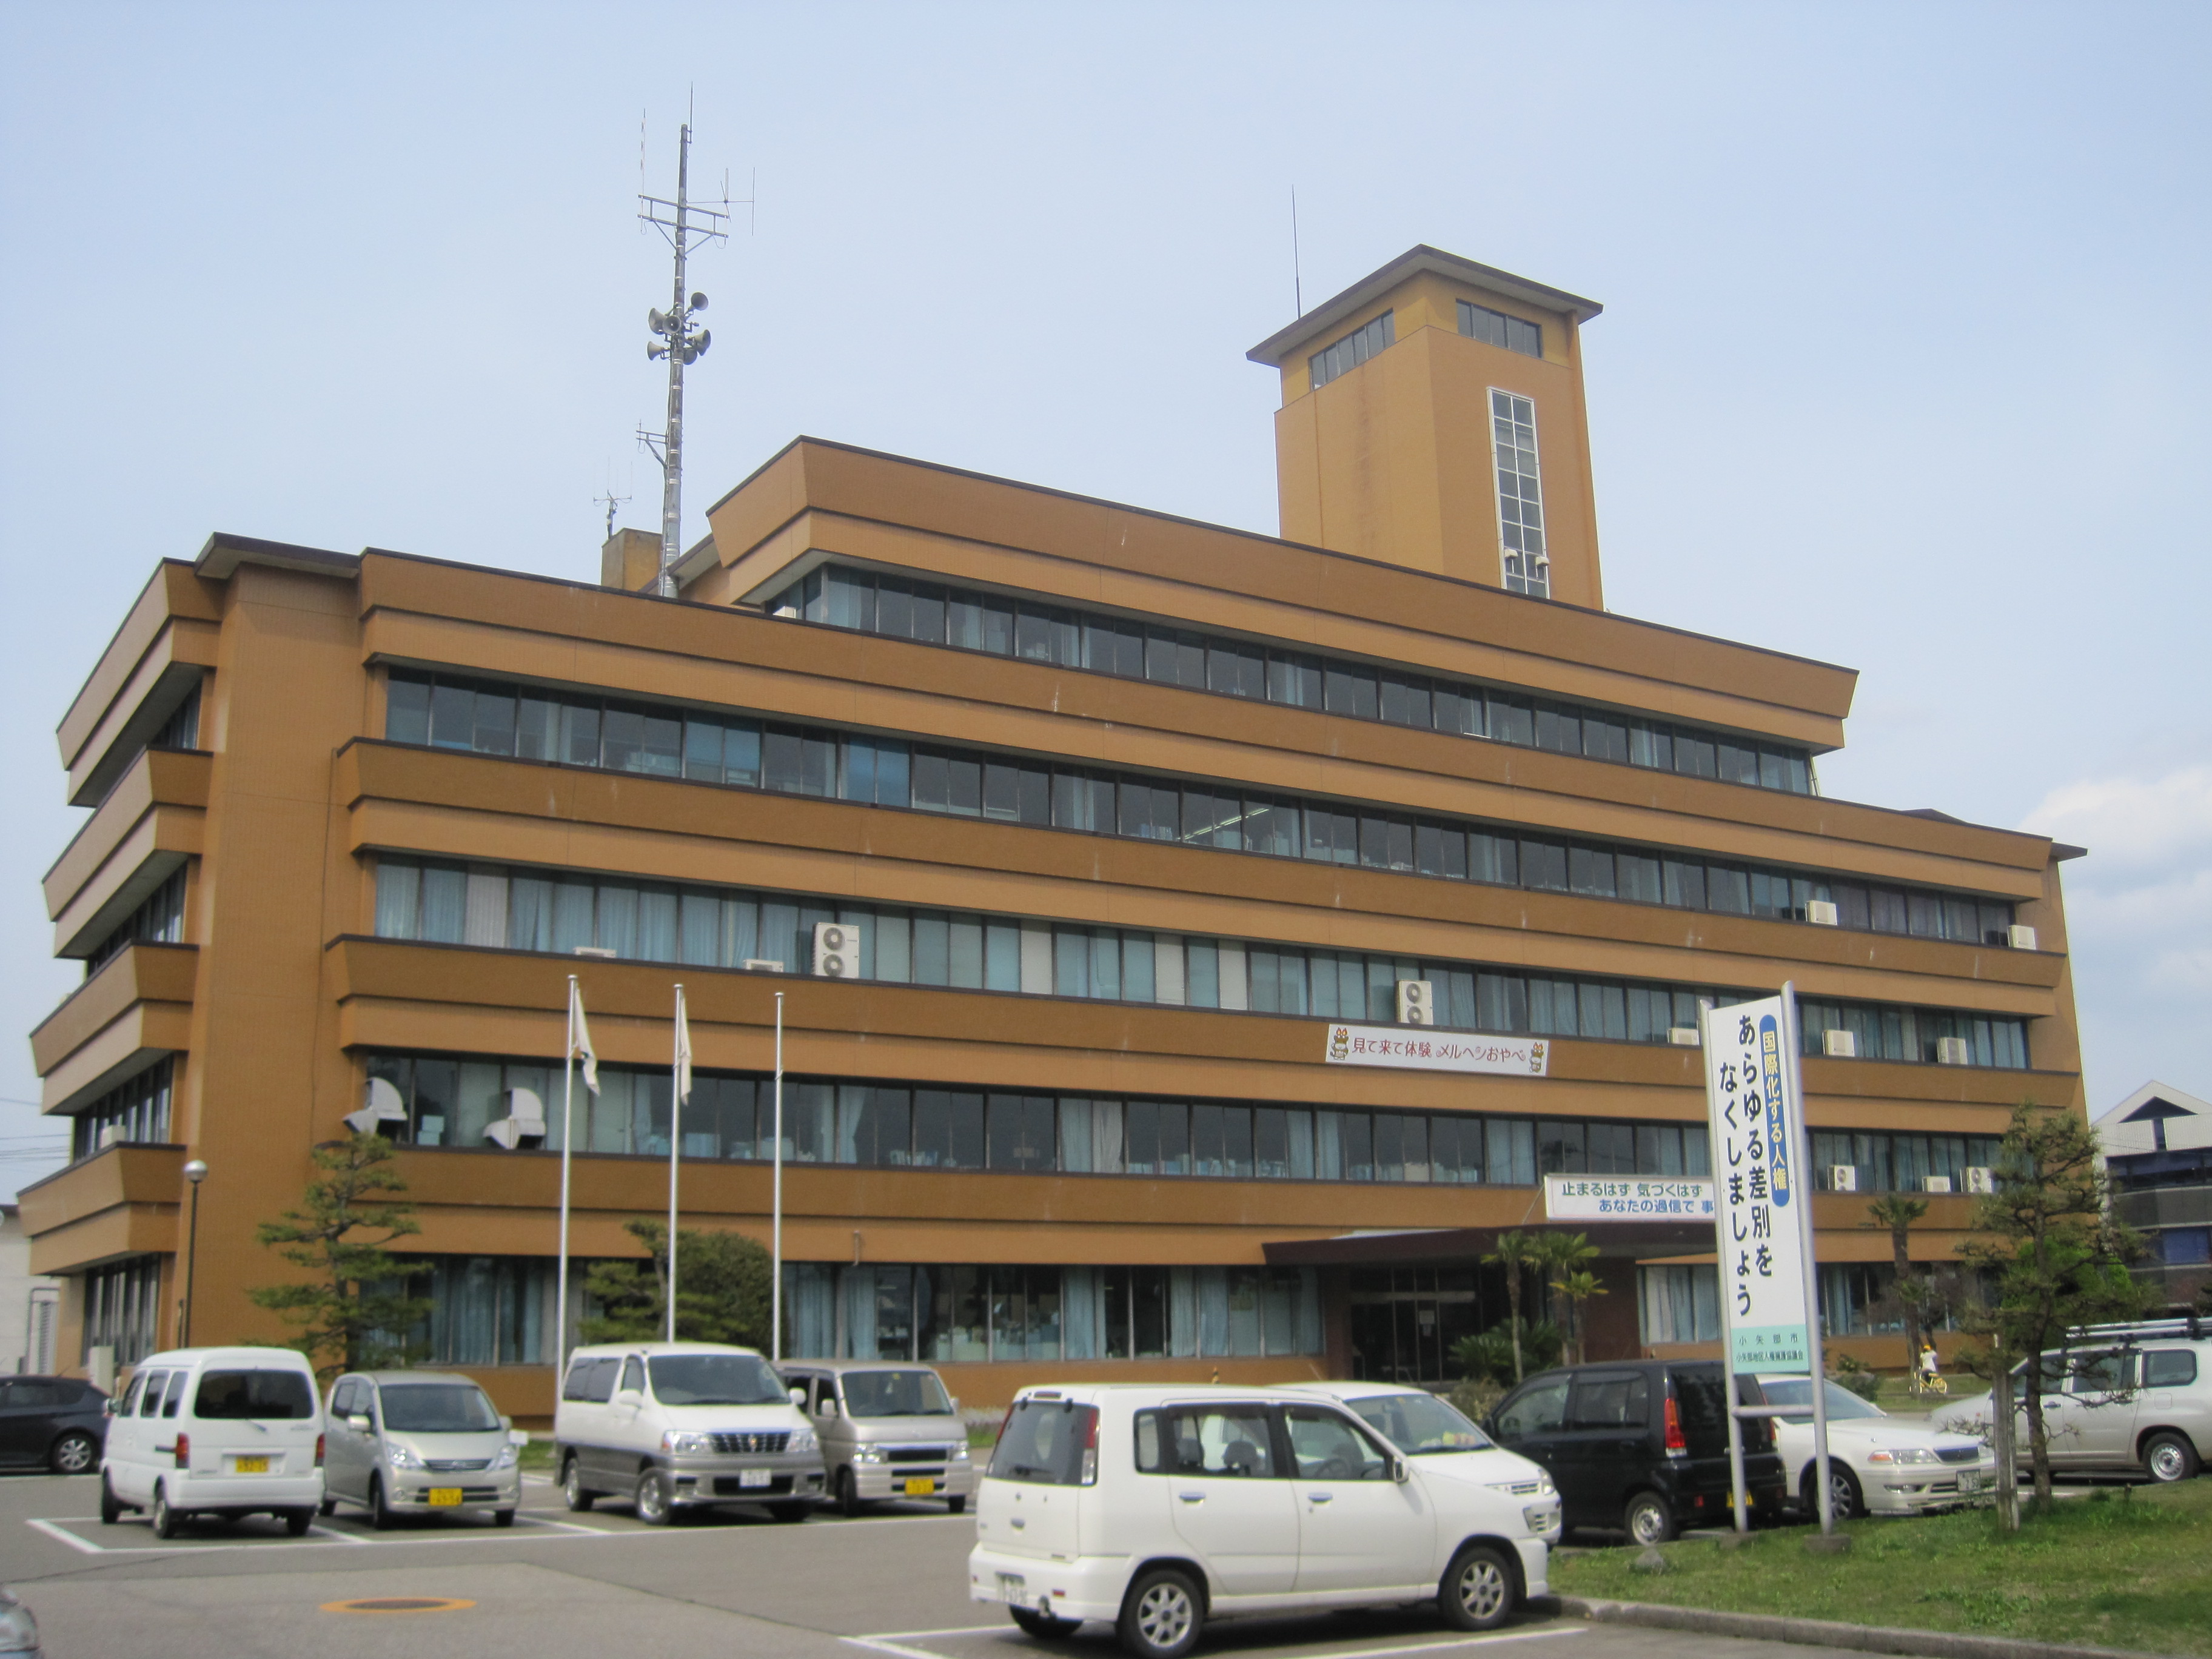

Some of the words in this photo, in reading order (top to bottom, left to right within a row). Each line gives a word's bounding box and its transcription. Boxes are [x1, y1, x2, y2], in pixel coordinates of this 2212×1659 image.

[1352, 1037, 1432, 1057] 見て来て体験
[1435, 1044, 1526, 1062] メルヘンおやべ
[1763, 1030, 1788, 1190] 国際化する人権
[1562, 1181, 1631, 1197] 止まるはず
[1637, 1182, 1703, 1197] 気づくはず
[1719, 1062, 1751, 1316] なくしましょう
[1738, 1014, 1773, 1277] あらゆる差別を
